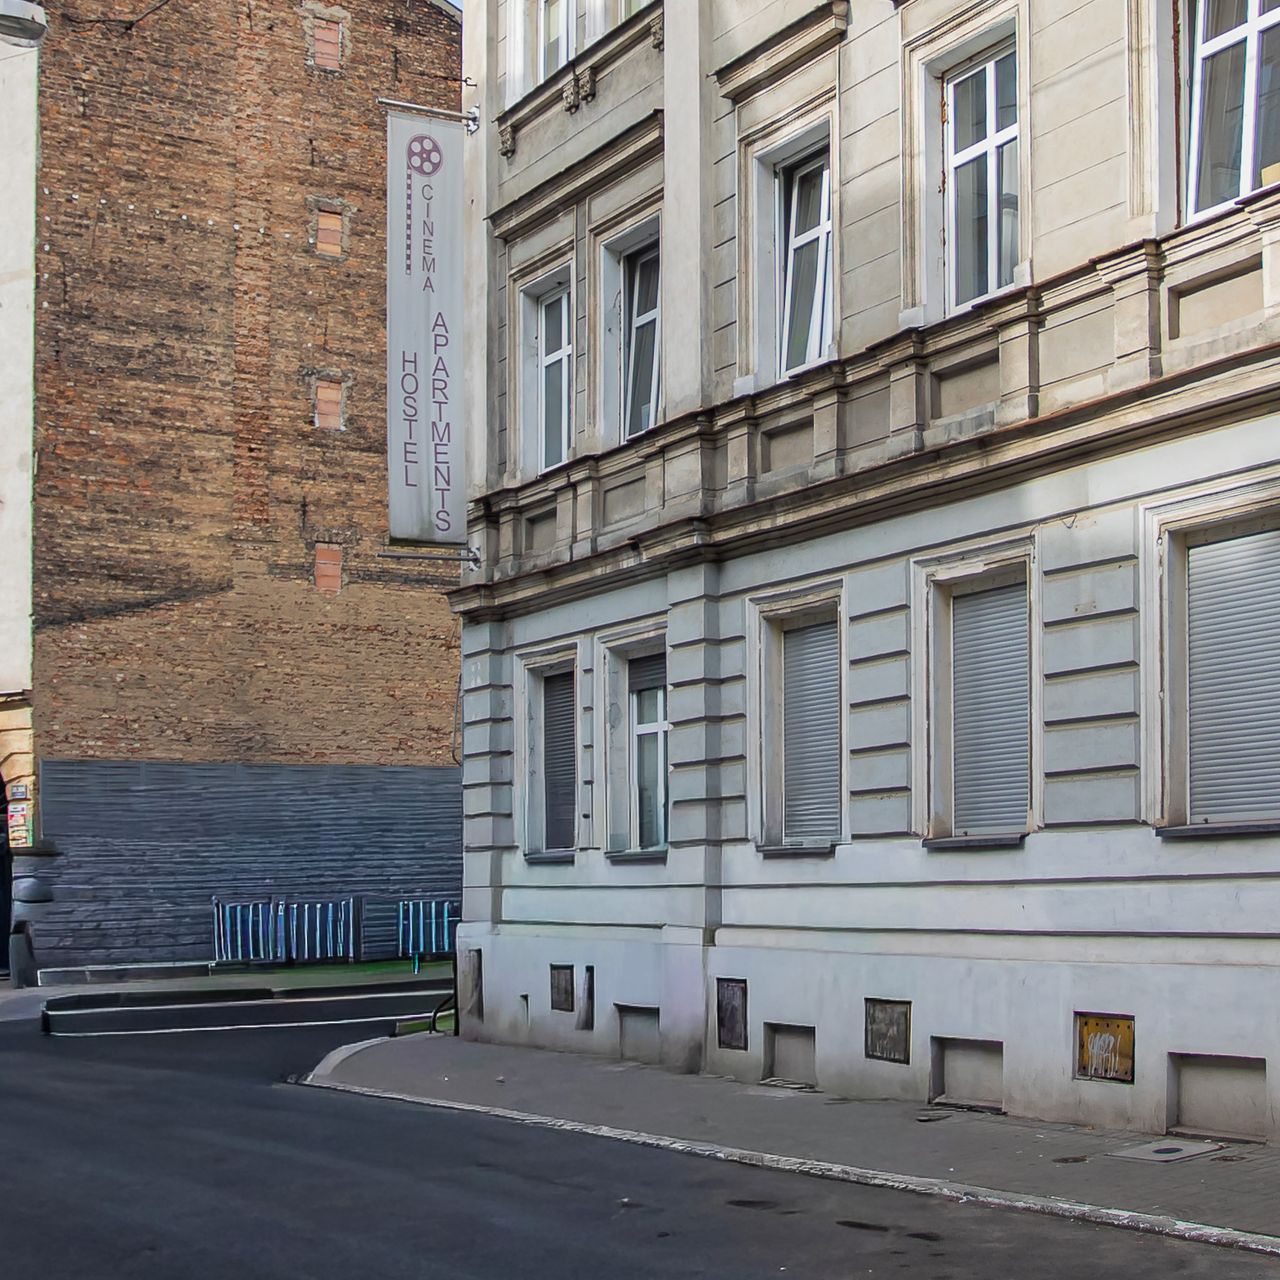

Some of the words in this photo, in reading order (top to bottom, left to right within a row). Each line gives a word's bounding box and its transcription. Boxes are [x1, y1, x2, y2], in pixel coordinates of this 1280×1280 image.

[420, 183, 437, 293] CINEMA
[400, 350, 419, 488] HOSTEL
[430, 311, 452, 533] APARTMENTS
